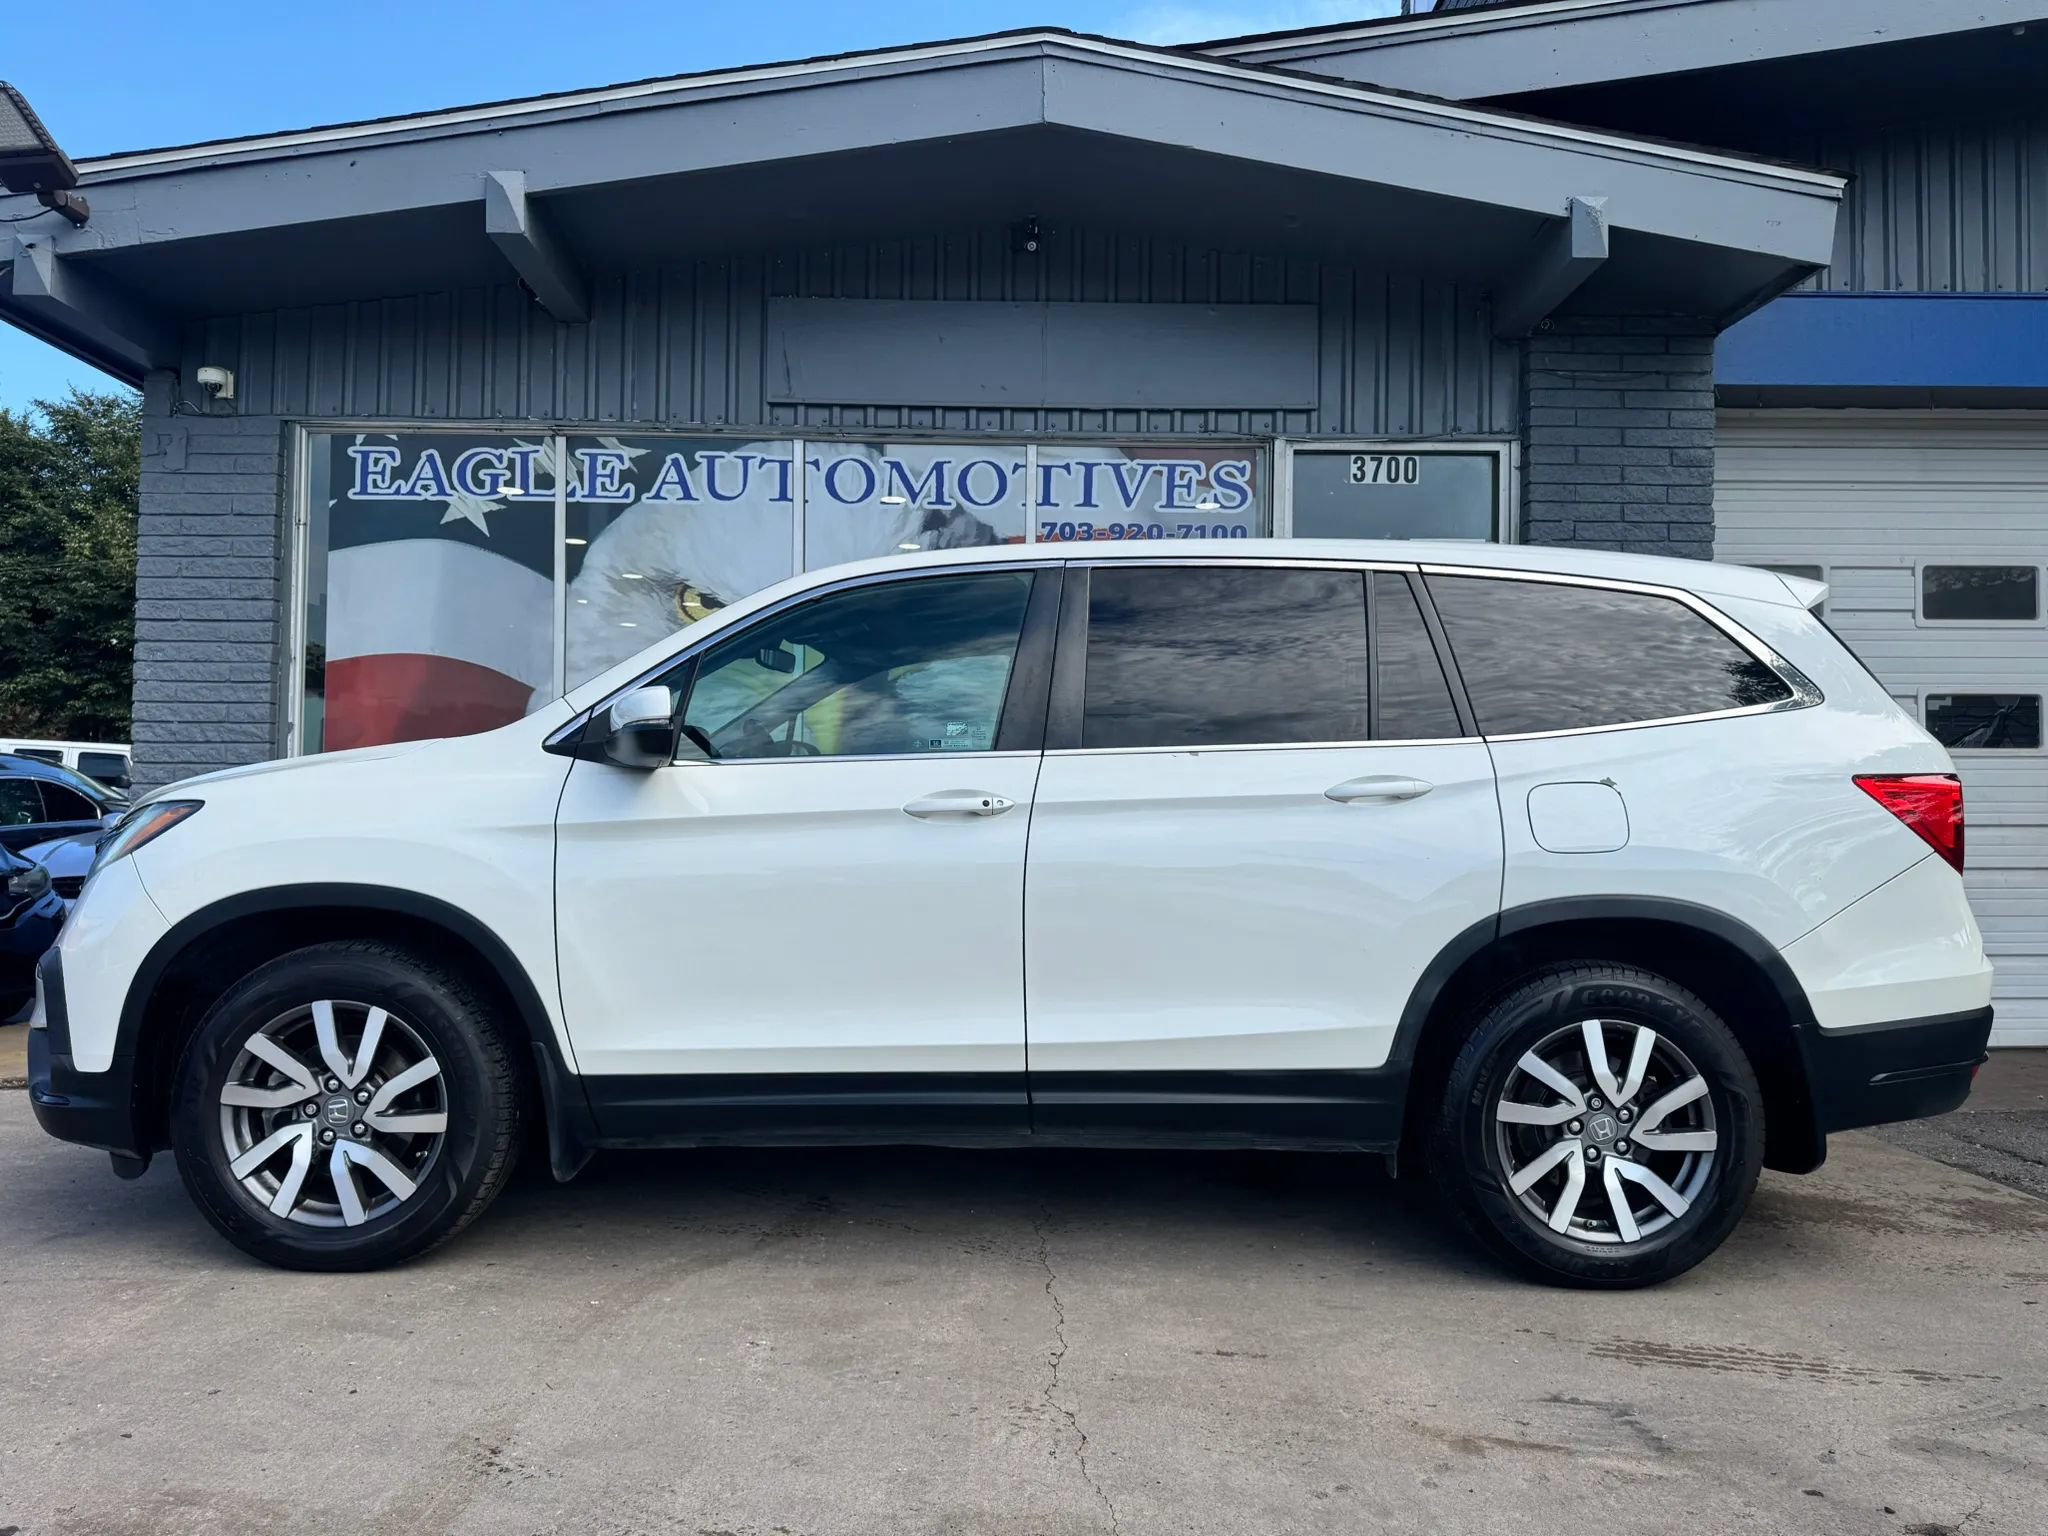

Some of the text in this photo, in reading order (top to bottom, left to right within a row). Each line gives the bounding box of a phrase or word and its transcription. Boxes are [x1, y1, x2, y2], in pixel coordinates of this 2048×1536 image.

[348, 446, 1252, 512] EAGLE AUTOMOTIVES
[1352, 455, 1417, 484] 3700
[1040, 521, 1249, 541] 703-920-7100
